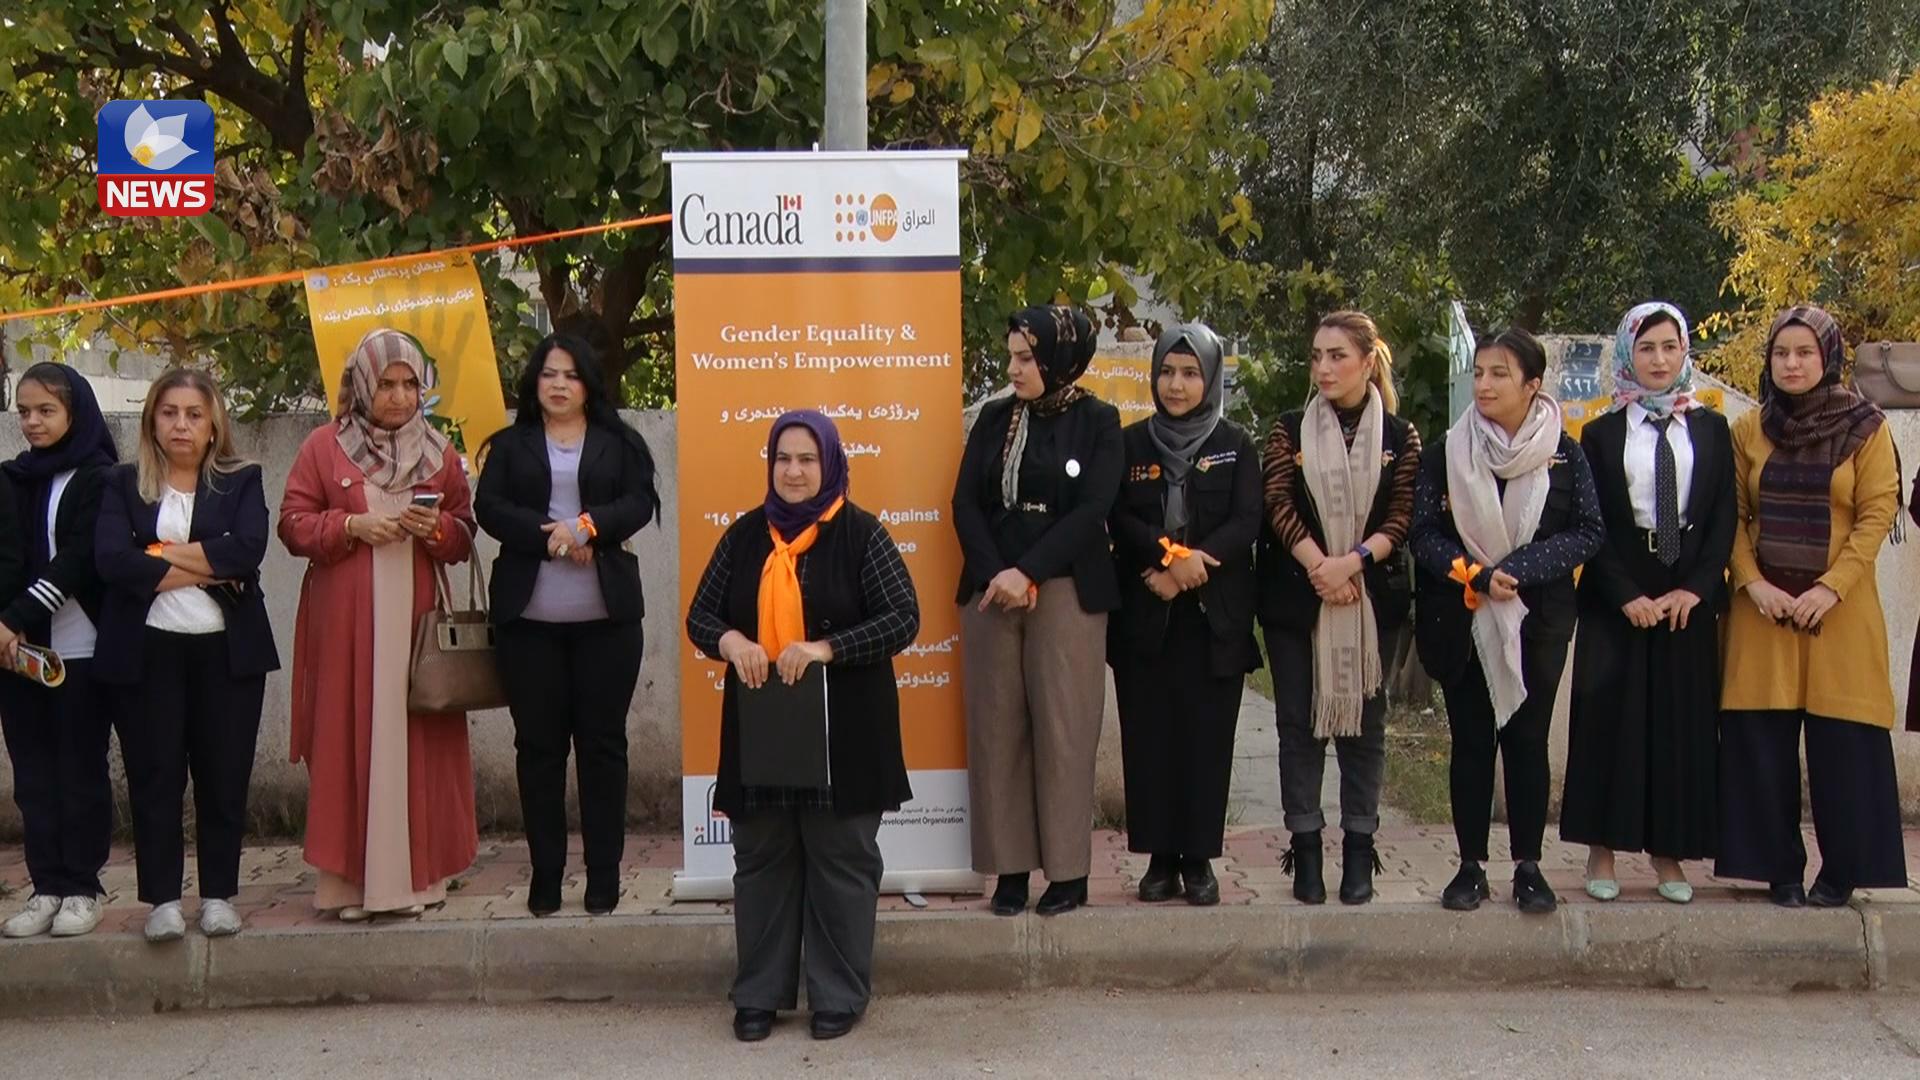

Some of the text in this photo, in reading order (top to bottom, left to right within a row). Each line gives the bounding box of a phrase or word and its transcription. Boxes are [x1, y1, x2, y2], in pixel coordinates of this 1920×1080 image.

[680, 193, 804, 246] Canada
[869, 211, 898, 226] UNFPA
[902, 210, 935, 231] العراق
[720, 324, 916, 345] Gender Equality &
[794, 352, 952, 373] Empowerment
[720, 403, 920, 423] پرۆژەی یەکسان ێندەری و
[878, 509, 940, 525] Against
[896, 671, 950, 689] توندوتی
[922, 816, 964, 826] Organization
